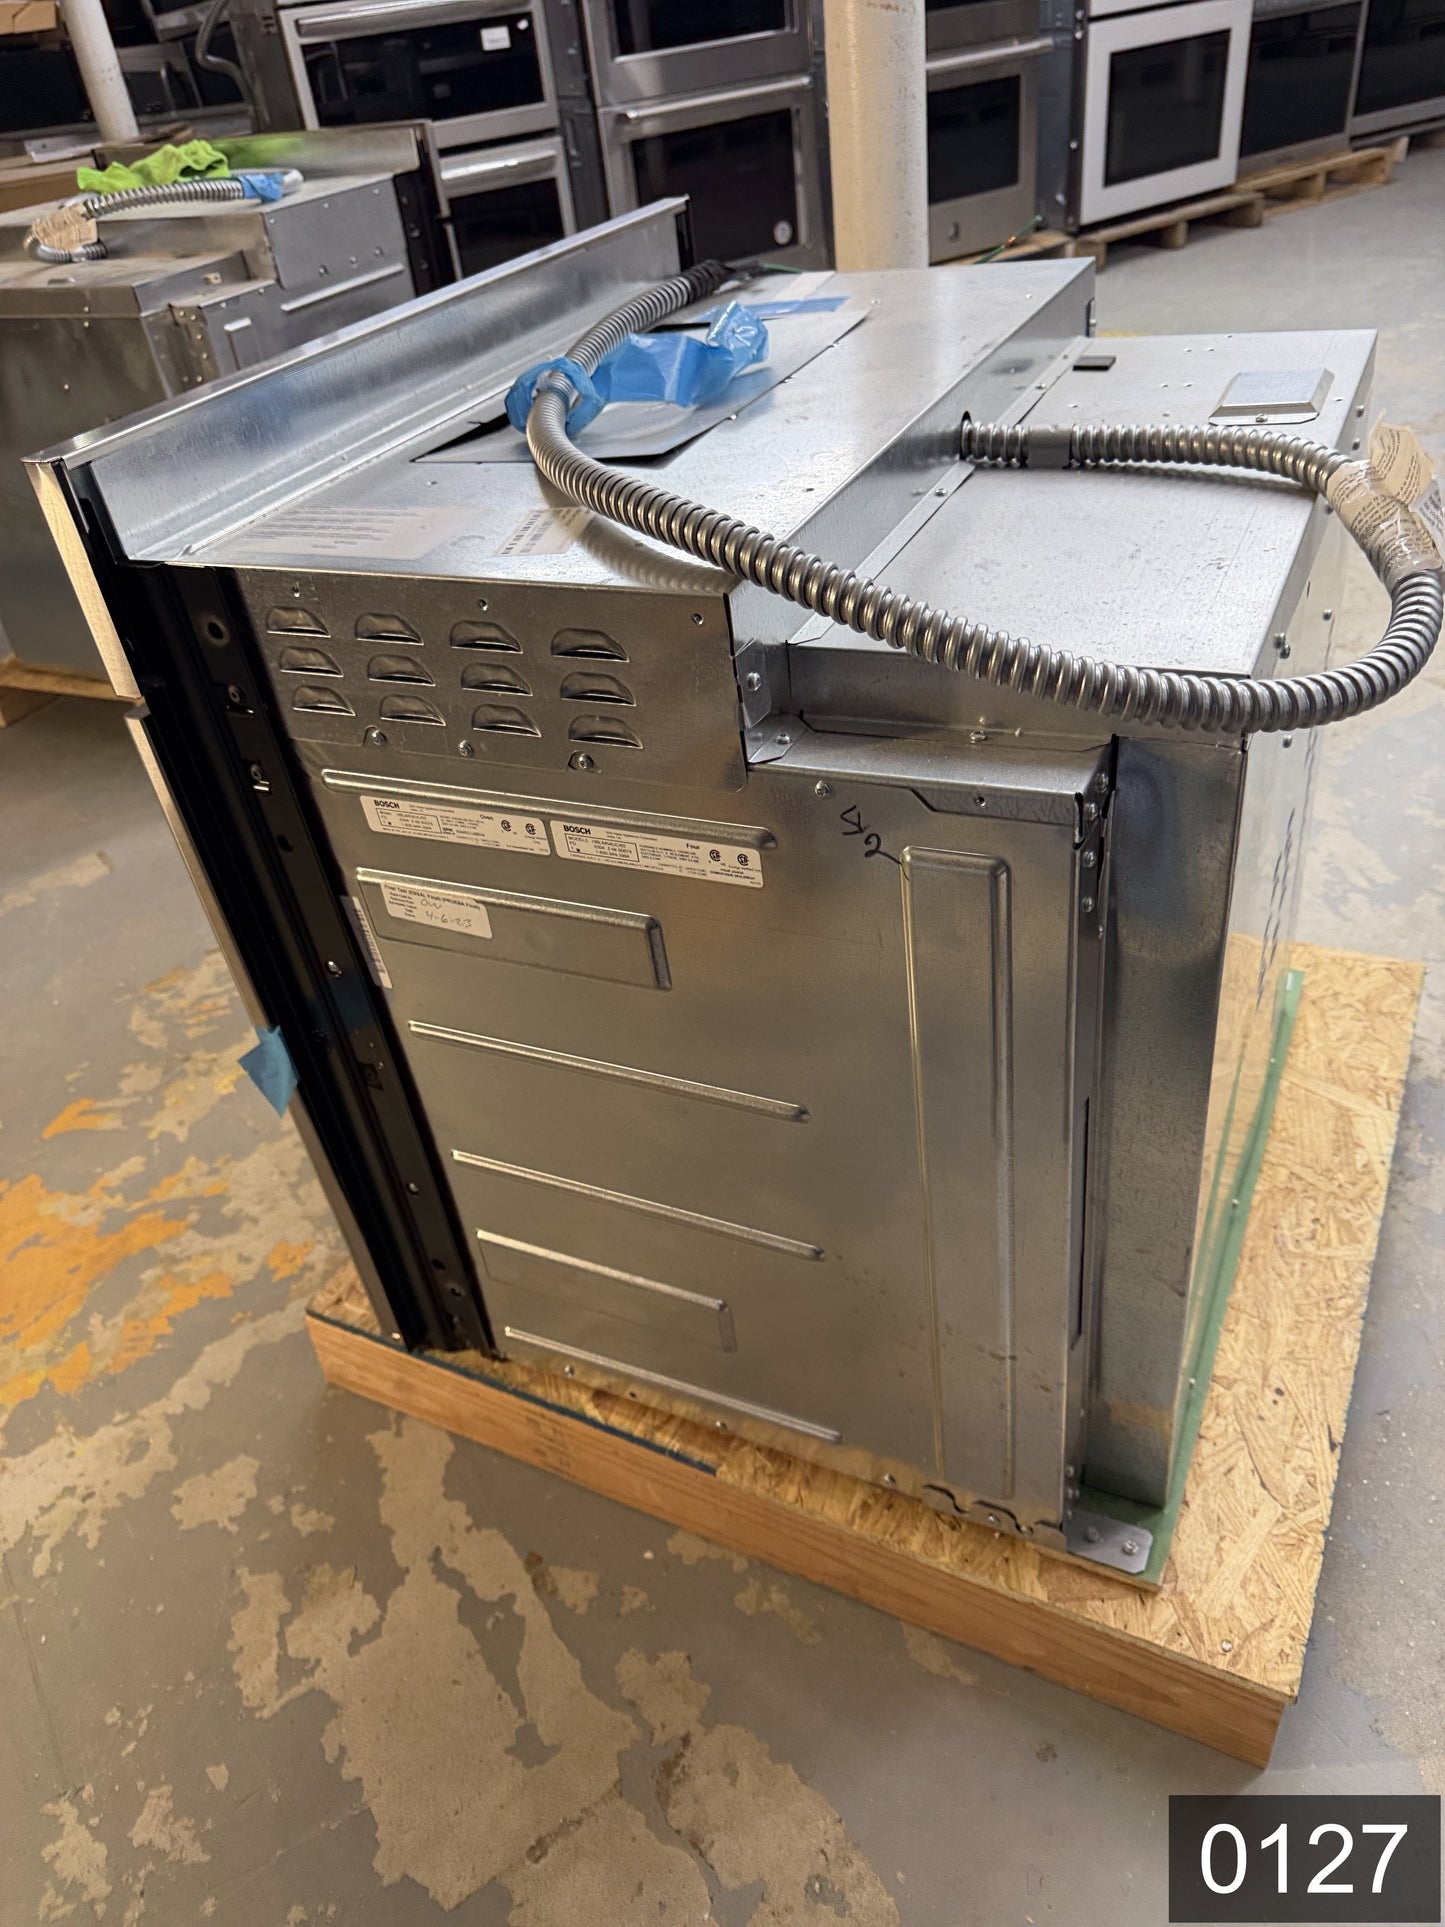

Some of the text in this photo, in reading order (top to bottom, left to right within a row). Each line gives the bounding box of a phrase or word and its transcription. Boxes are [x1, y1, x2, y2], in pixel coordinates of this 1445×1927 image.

[374, 799, 400, 809] BOSCH
[563, 824, 592, 835] BOSCH
[425, 910, 472, 928] 4-6-23
